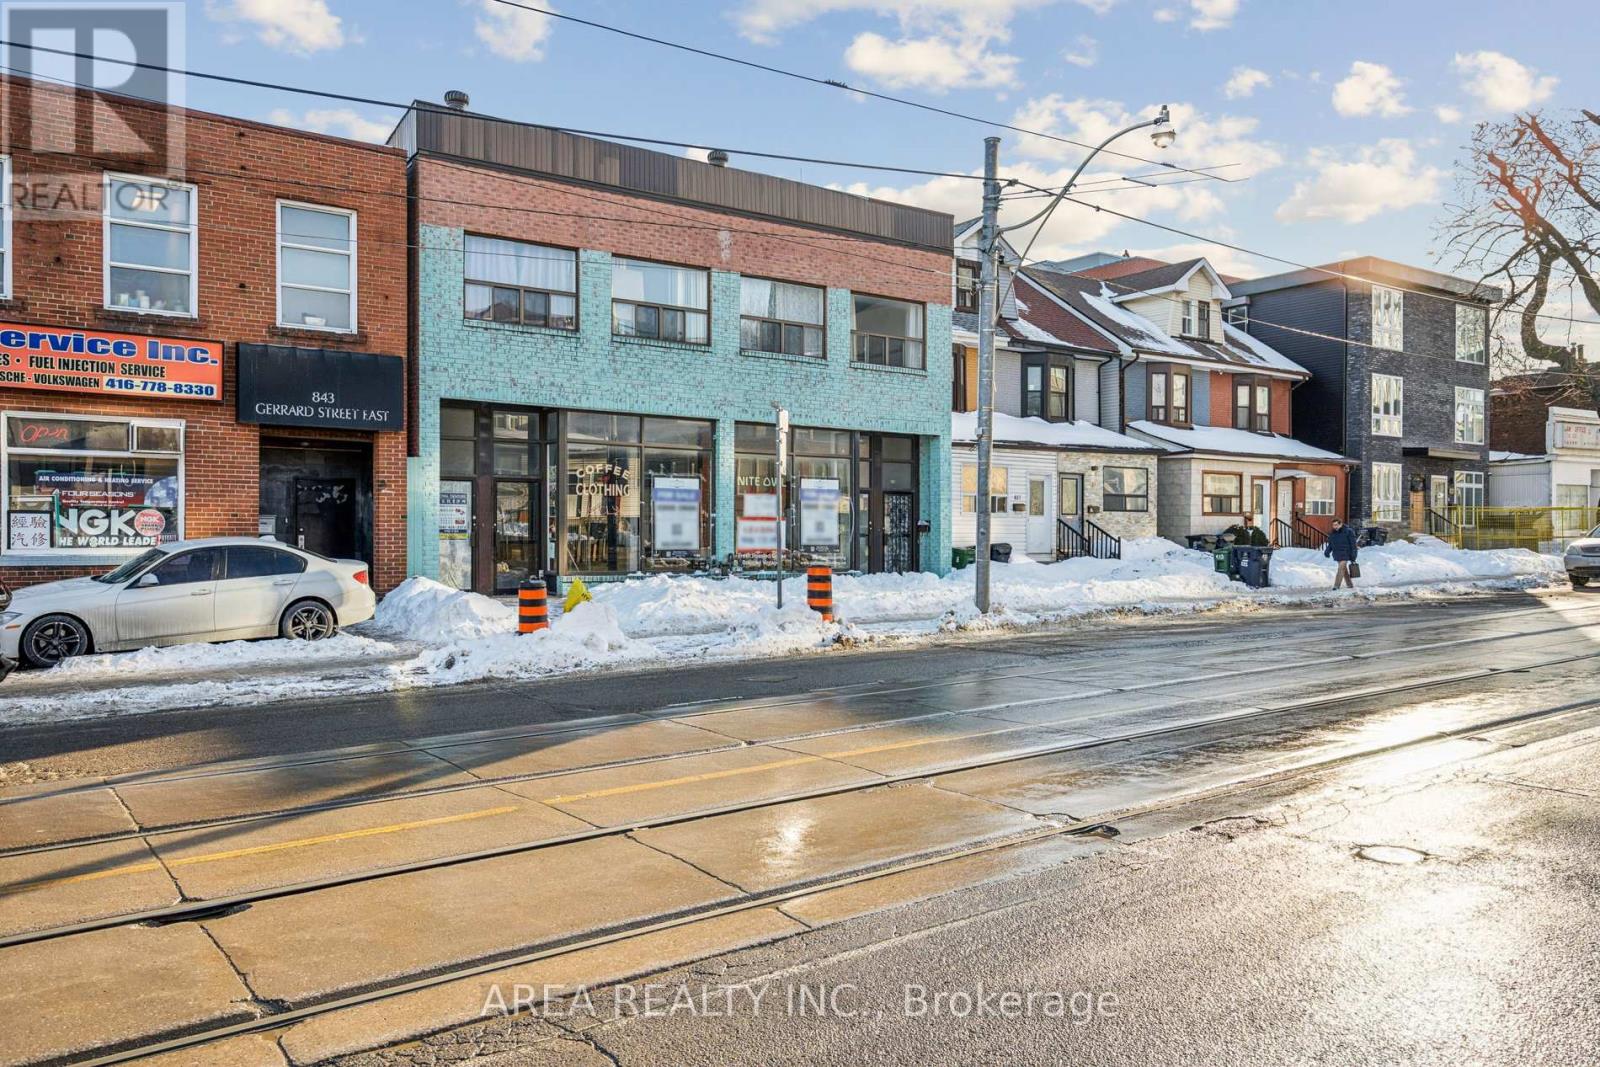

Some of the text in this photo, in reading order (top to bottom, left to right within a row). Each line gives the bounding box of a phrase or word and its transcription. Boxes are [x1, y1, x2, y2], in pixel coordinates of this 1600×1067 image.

[0, 330, 218, 364] ervice Inc.
[29, 355, 55, 370] FUEL
[58, 358, 115, 374] INJECTION
[120, 363, 165, 378] SERVICE
[34, 374, 100, 388] VOLKSWAGEN
[105, 378, 214, 396] 416-778-8330
[312, 391, 335, 404] 843
[255, 402, 389, 422] GERRARD STREET EAST
[576, 463, 631, 480] COFFEE
[576, 483, 630, 497] CLOTHING
[737, 476, 761, 487] NITE
[58, 508, 137, 537] NGK
[11, 532, 48, 547] 汽修
[59, 536, 74, 546] HE
[78, 536, 119, 547] WORLD
[122, 536, 157, 546] LEADE
